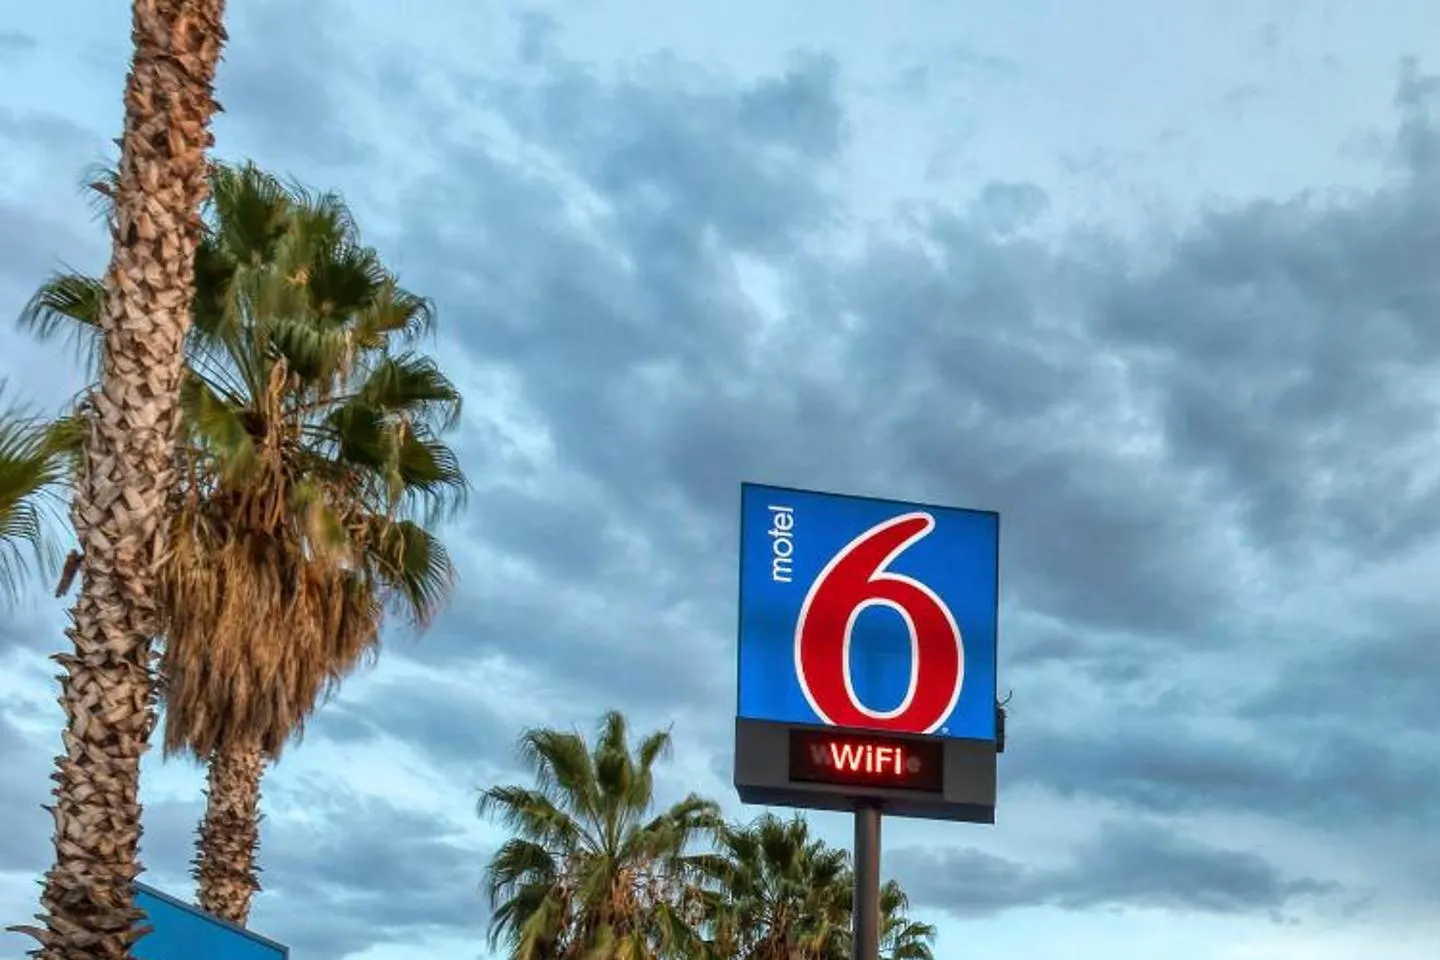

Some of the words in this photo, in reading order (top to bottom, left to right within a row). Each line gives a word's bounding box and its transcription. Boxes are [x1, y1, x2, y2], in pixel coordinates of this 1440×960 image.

[768, 505, 794, 582] motel
[794, 512, 964, 735] 6
[830, 743, 902, 775] WiFi
